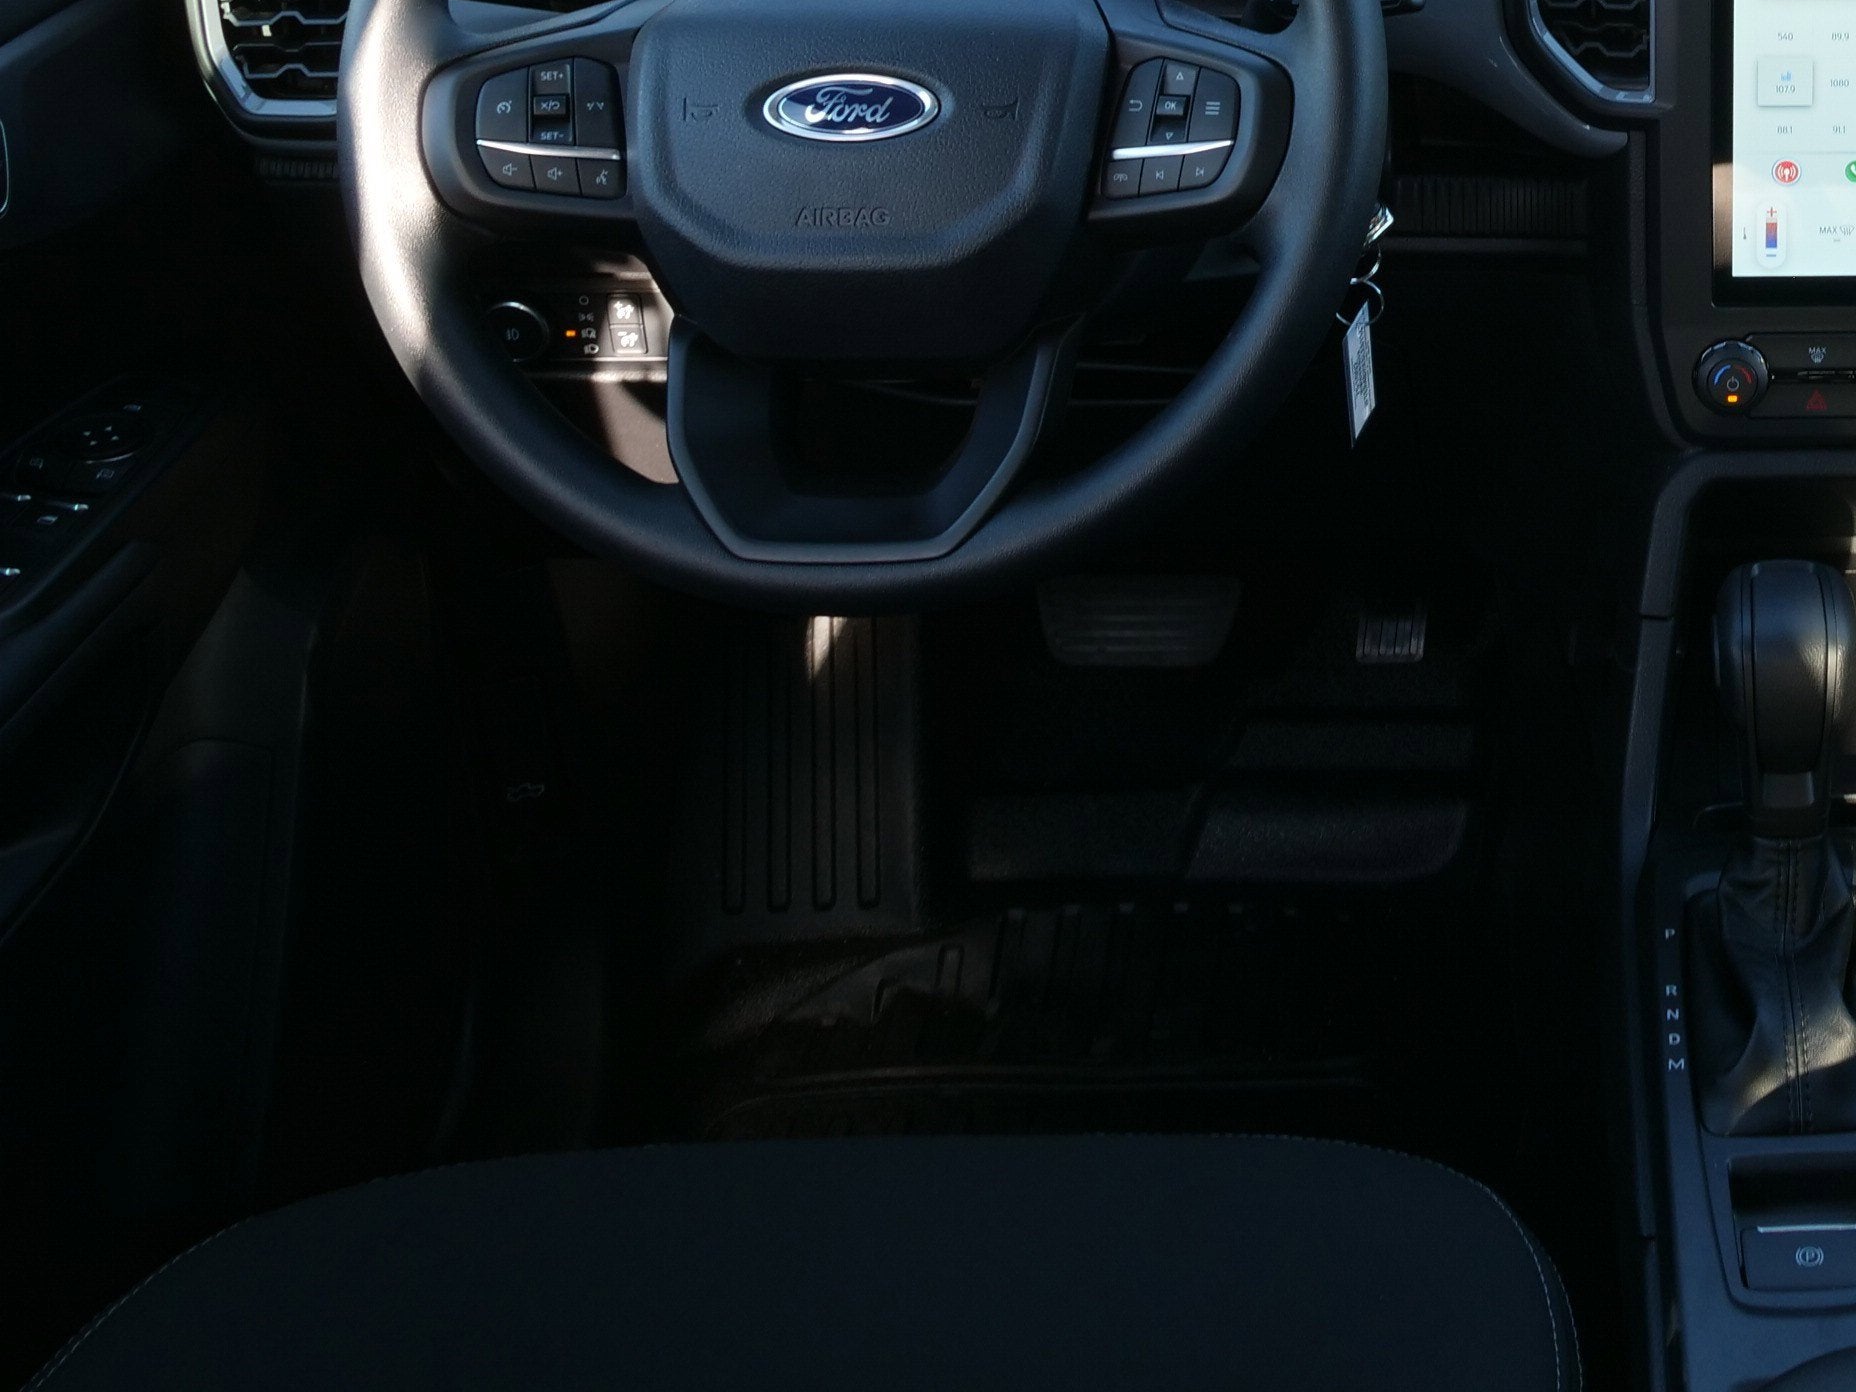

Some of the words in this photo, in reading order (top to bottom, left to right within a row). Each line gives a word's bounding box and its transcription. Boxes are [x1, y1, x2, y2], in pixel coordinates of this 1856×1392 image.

[540, 70, 563, 81] SET+
[804, 86, 894, 123] Ford
[1164, 100, 1177, 110] OK
[795, 206, 893, 228] AIRBAG
[1819, 226, 1837, 235] MAX
[1808, 347, 1827, 355] MAX
[1665, 929, 1675, 939] P
[1665, 985, 1677, 996] R
[1667, 1008, 1679, 1021] N
[1668, 1033, 1681, 1045] D
[1668, 1058, 1685, 1070] M
